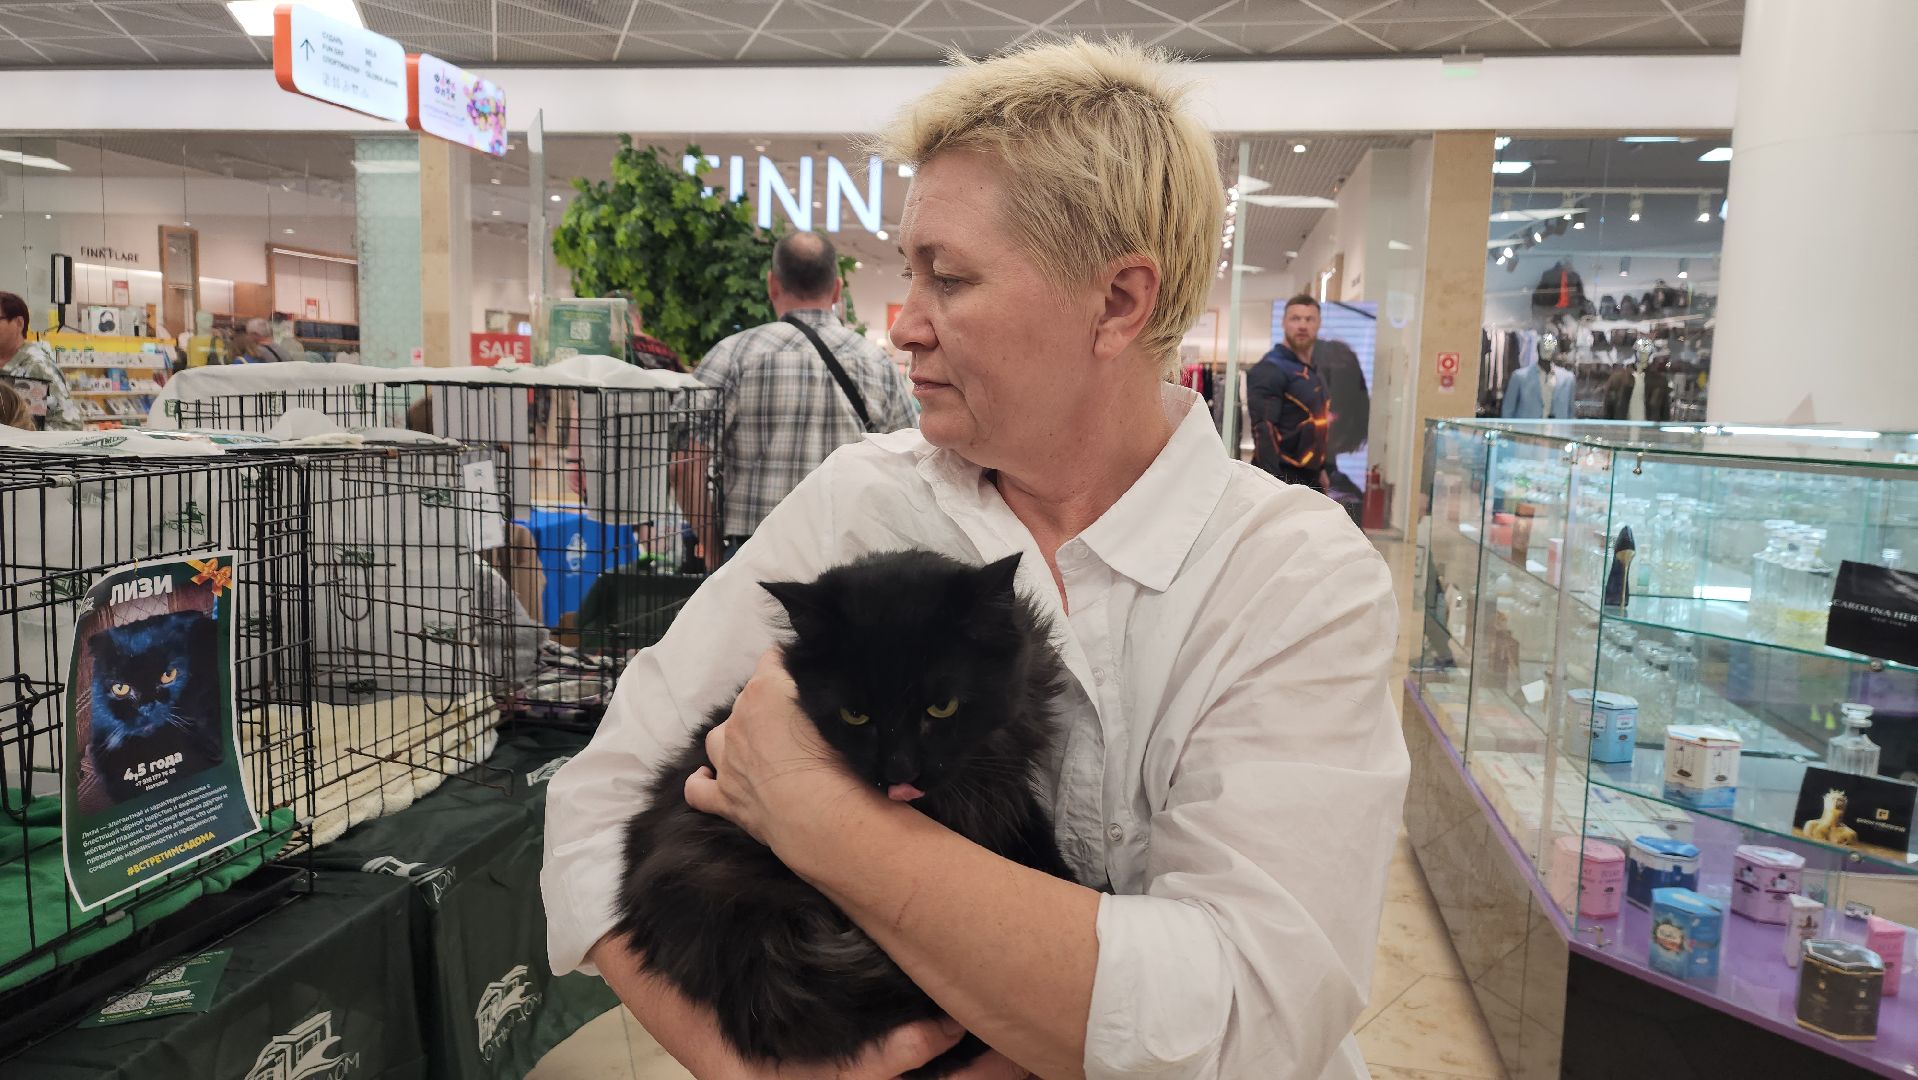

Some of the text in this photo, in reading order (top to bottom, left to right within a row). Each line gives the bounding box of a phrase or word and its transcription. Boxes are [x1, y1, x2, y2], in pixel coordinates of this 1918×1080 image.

[479, 339, 523, 360] SALE
[109, 574, 173, 607] ЛИЗИ
[1893, 611, 1918, 623] HER
[123, 751, 183, 781] 4,5 года
[144, 821, 158, 831] Она
[158, 812, 178, 825] станет
[178, 804, 202, 818] верным
[202, 795, 223, 809] другом
[144, 806, 173, 823] шерстью
[86, 843, 129, 865] прекрасным
[172, 818, 185, 829] для
[196, 809, 207, 819] кто
[206, 802, 224, 815] ценит
[88, 854, 125, 874] сочетание
[124, 833, 174, 859] независимости
[126, 831, 216, 876] #ВСТРЕТИМСЯДОМА
